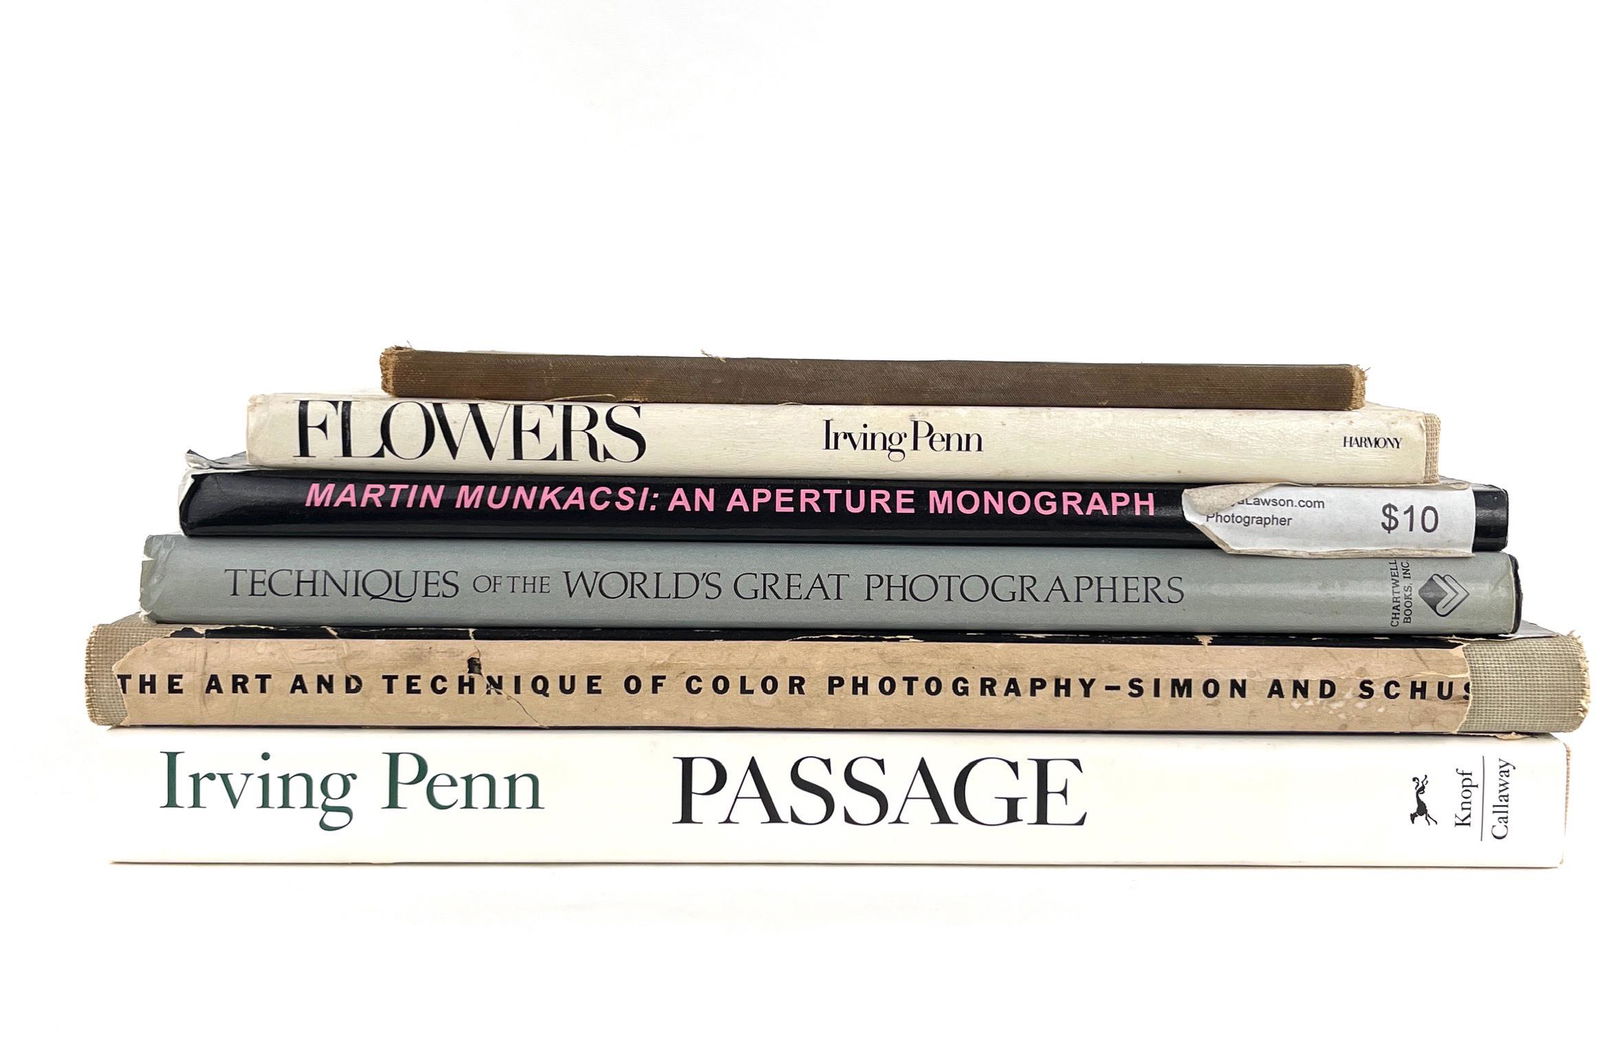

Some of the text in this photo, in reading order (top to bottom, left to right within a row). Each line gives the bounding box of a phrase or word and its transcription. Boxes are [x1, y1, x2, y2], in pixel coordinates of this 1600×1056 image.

[293, 399, 647, 463] FLOWERS
[823, 418, 983, 462] Irving Penn
[1343, 436, 1402, 449] HARMONY
[305, 483, 1155, 516] MARTIN MUNKACSI: AN APERTURE MONOGRAPH
[1201, 511, 1293, 527] Photographer
[1381, 503, 1439, 535] $10
[225, 569, 1185, 604] TECHNIQUES OF THE WORLD'S GREAT PHOTOGRAPHERS
[1389, 559, 1400, 628] CHARTWELL
[116, 674, 184, 695] THE
[205, 674, 272, 695] ART
[289, 674, 363, 695] AND
[382, 675, 602, 697] TECHNIQUE
[623, 675, 667, 695] OF
[685, 675, 806, 695] COLOR
[1267, 679, 1336, 698] AND
[160, 751, 545, 831] Irving Penn
[673, 756, 1088, 827] PASSAGE
[1455, 768, 1479, 827] Knopf
[1491, 758, 1516, 840] Callaway
